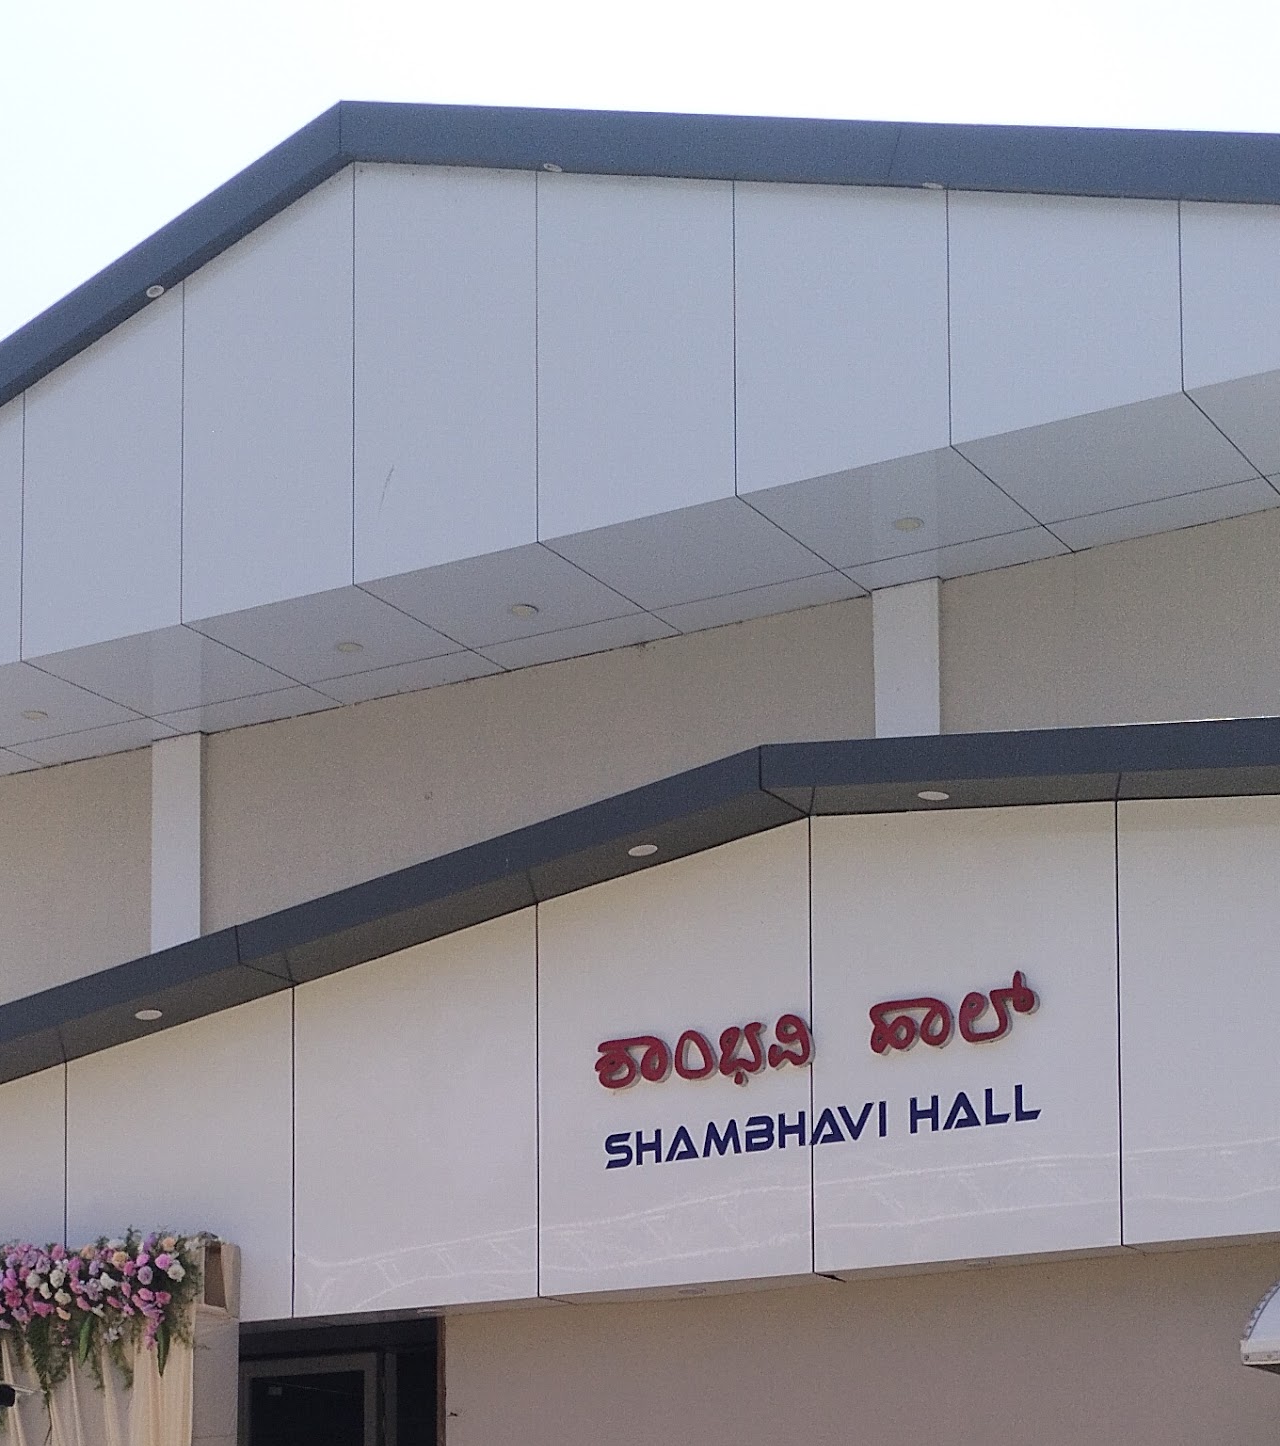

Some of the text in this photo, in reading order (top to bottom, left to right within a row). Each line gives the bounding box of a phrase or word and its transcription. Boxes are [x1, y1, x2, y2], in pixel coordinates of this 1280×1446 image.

[595, 971, 1037, 1089] ಶಾಂಭವಿ ಹಾಲ್
[605, 1084, 1041, 1169] SHAMBHAVI HALL
